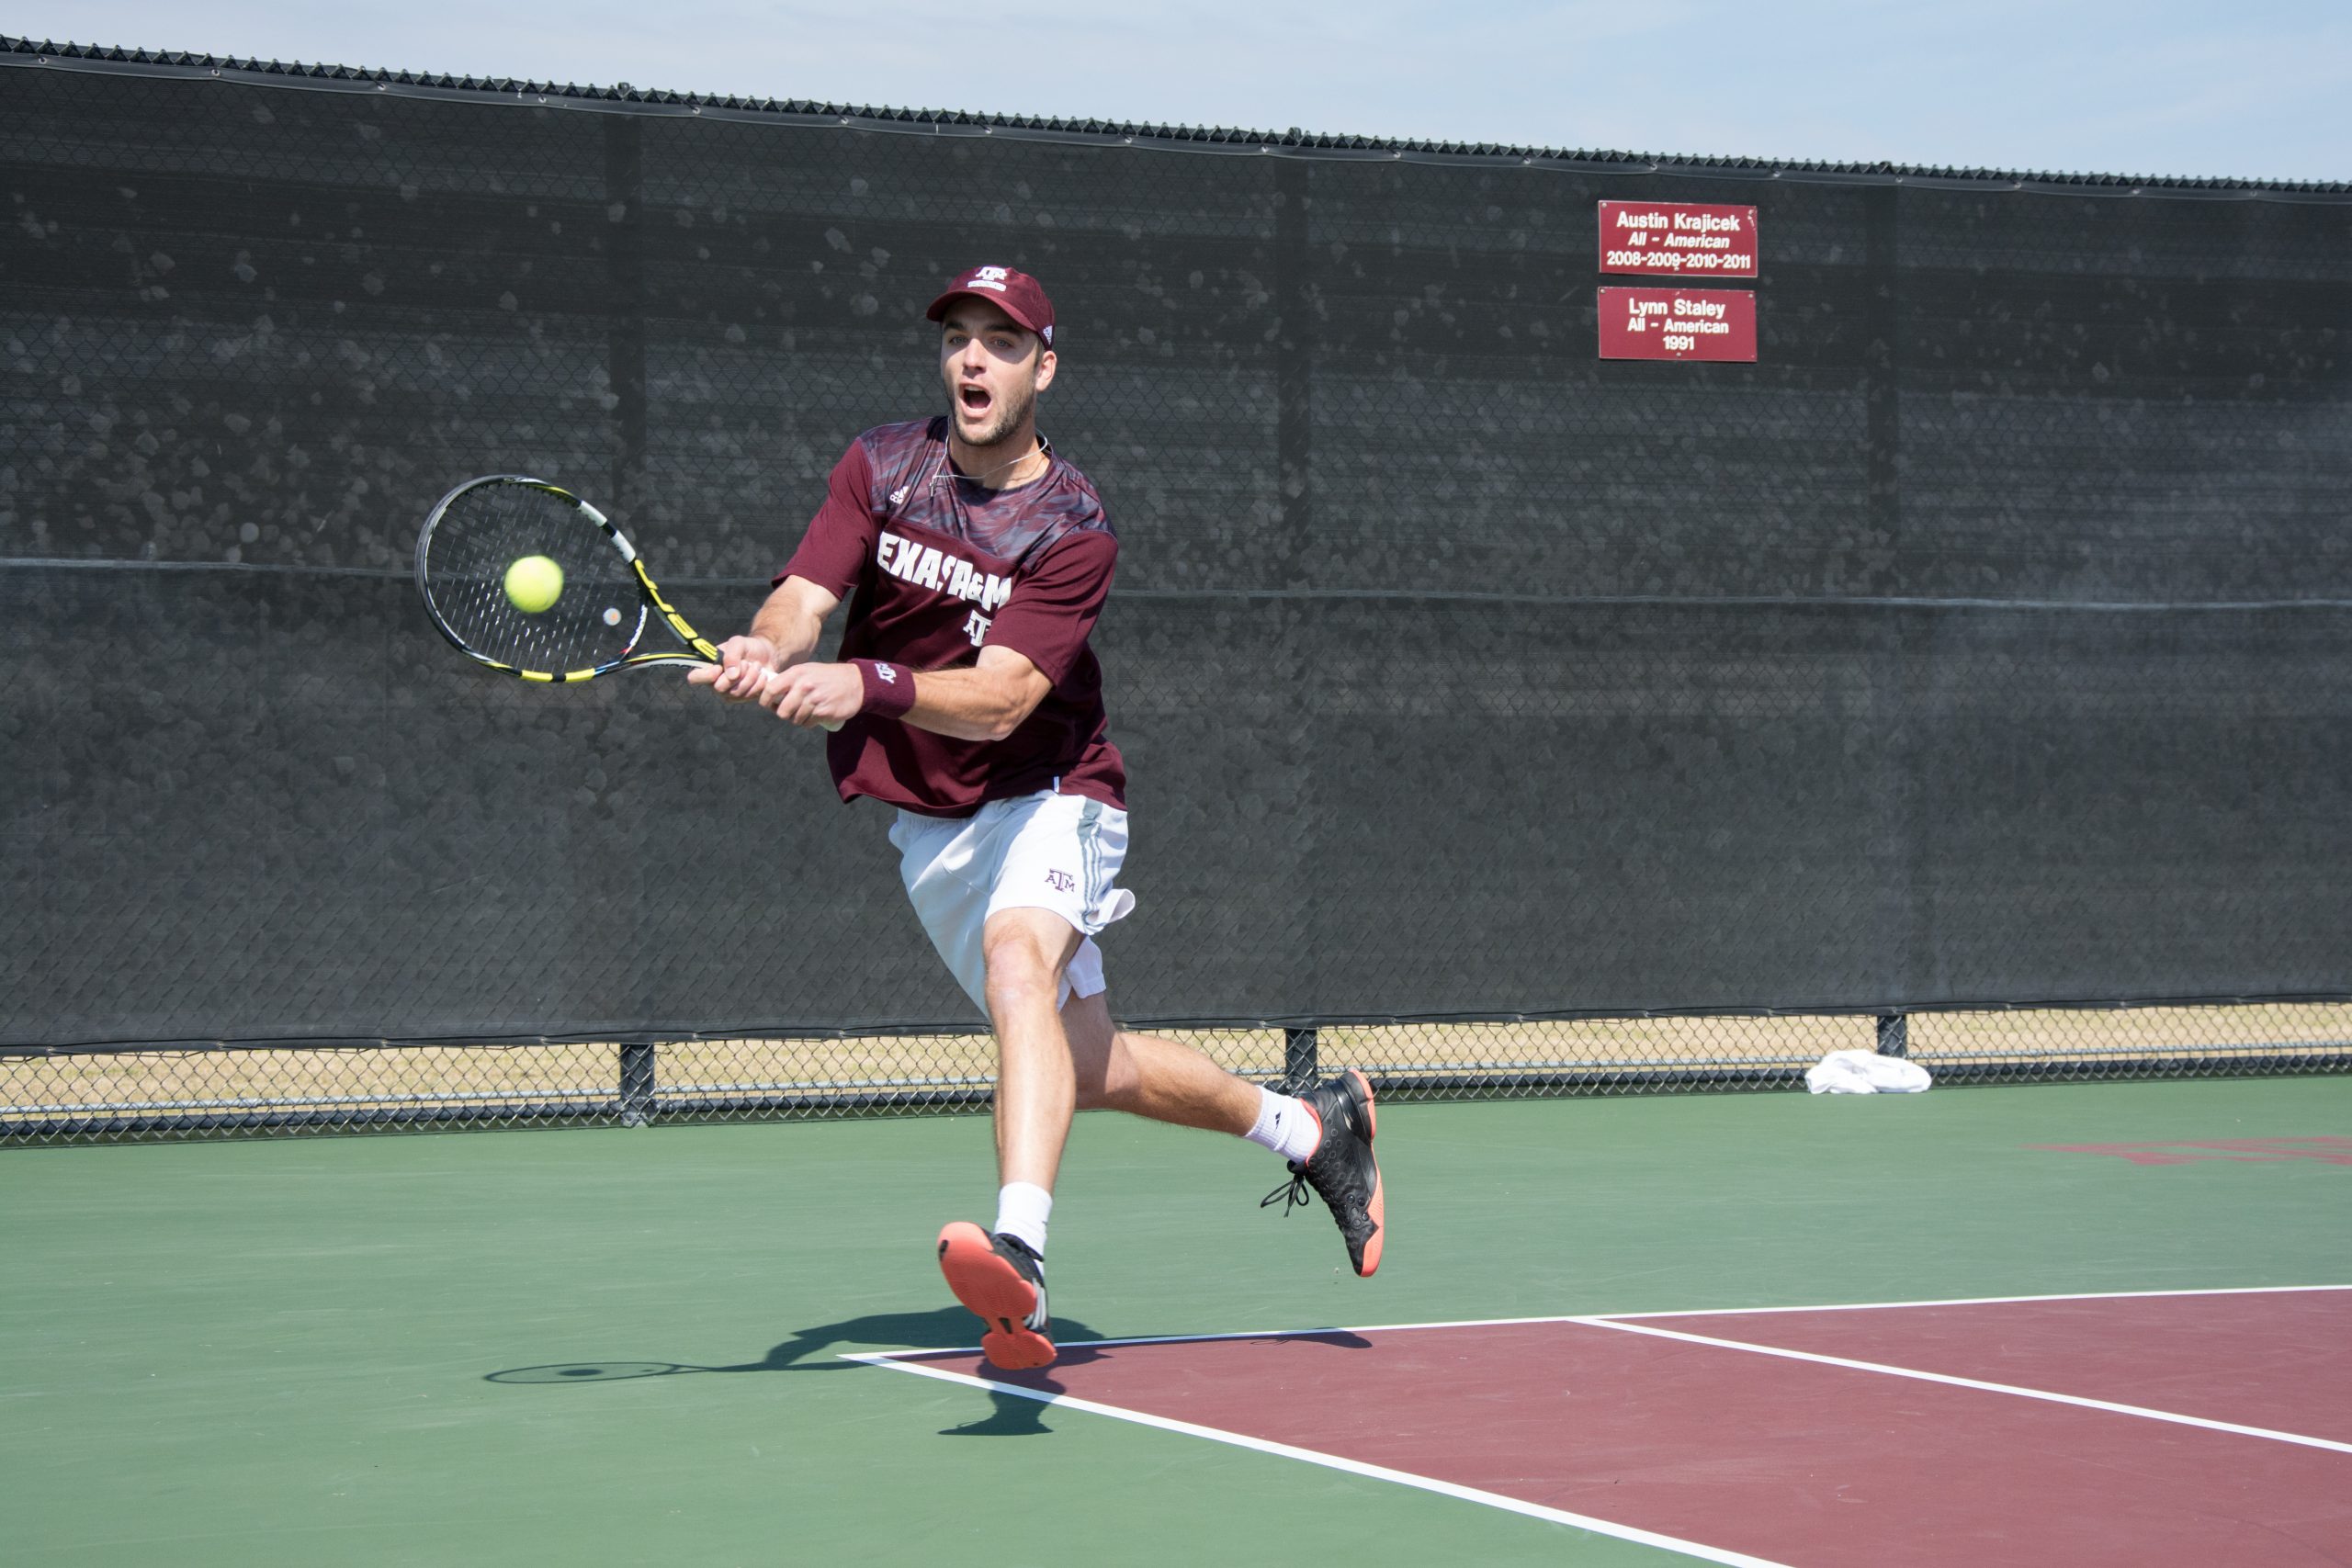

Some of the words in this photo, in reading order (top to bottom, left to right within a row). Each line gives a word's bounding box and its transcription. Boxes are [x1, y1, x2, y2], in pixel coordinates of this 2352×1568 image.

[1617, 210, 1668, 229] Austin
[1674, 212, 1740, 232] Krajicek
[1628, 231, 1647, 246] All
[1664, 233, 1730, 248] American
[1607, 251, 1750, 269] 2008-2009-2010-2011
[1628, 298, 1668, 317] Lynn
[1674, 299, 1725, 319] Staley
[1627, 318, 1645, 332] All
[1663, 319, 1729, 333] American
[1663, 335, 1694, 350] 1991
[876, 531, 957, 592] EXAS
[947, 559, 1012, 611] A&M
